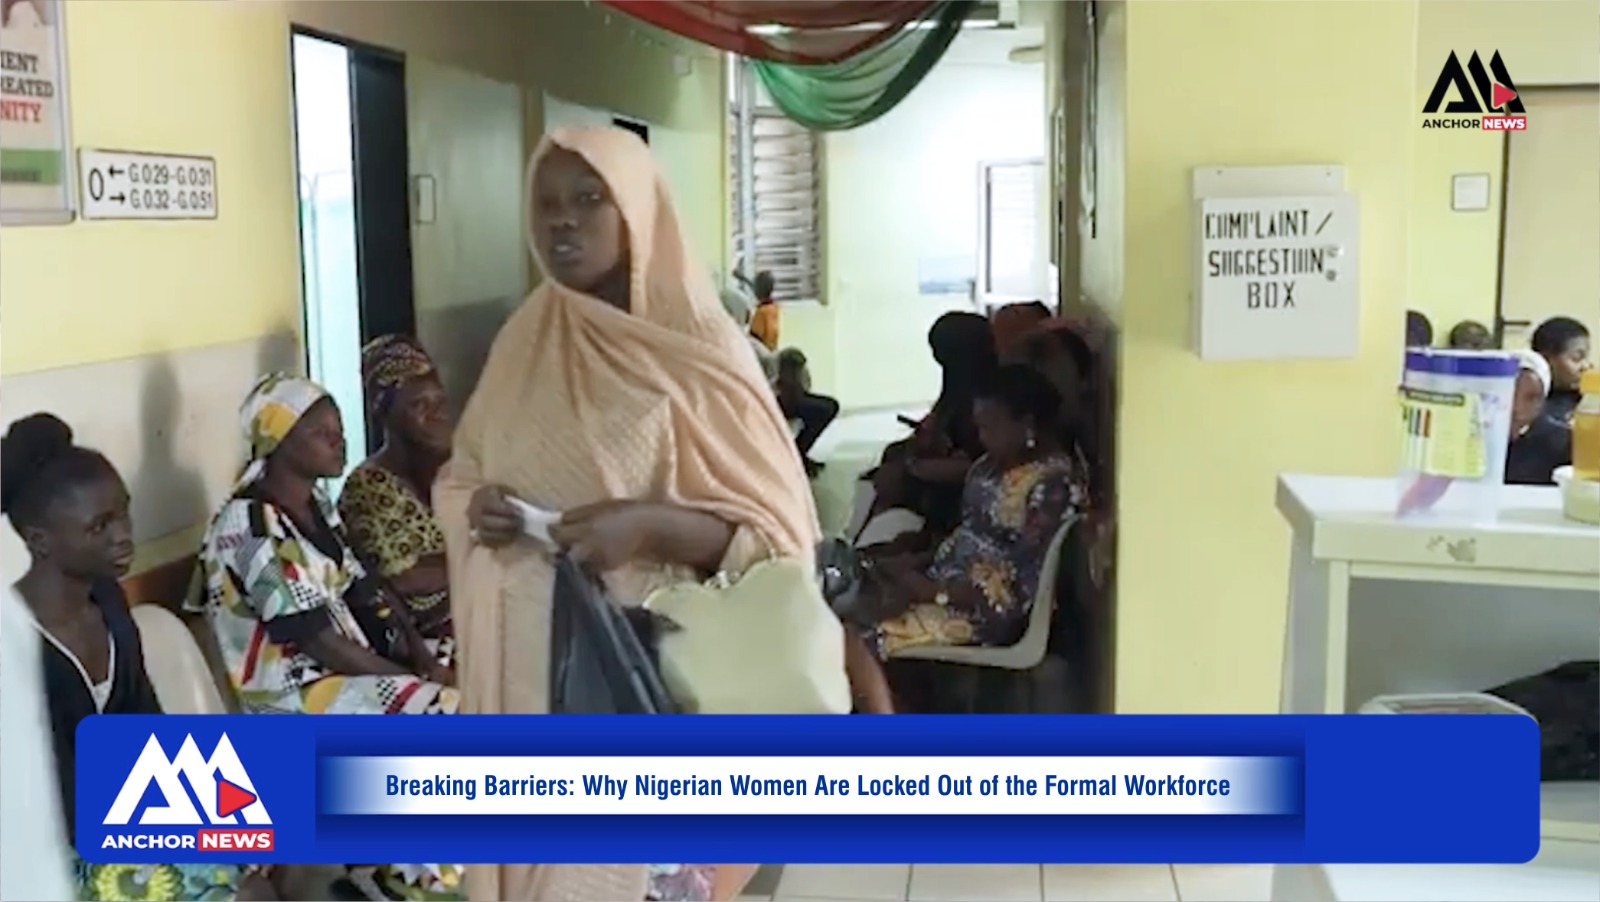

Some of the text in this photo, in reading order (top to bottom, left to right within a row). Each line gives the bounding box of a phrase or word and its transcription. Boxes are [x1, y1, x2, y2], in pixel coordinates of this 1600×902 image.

[1205, 210, 1308, 239] COMPLAINT
[1208, 248, 1324, 277] SUGGESTION
[1247, 281, 1296, 308] BOX
